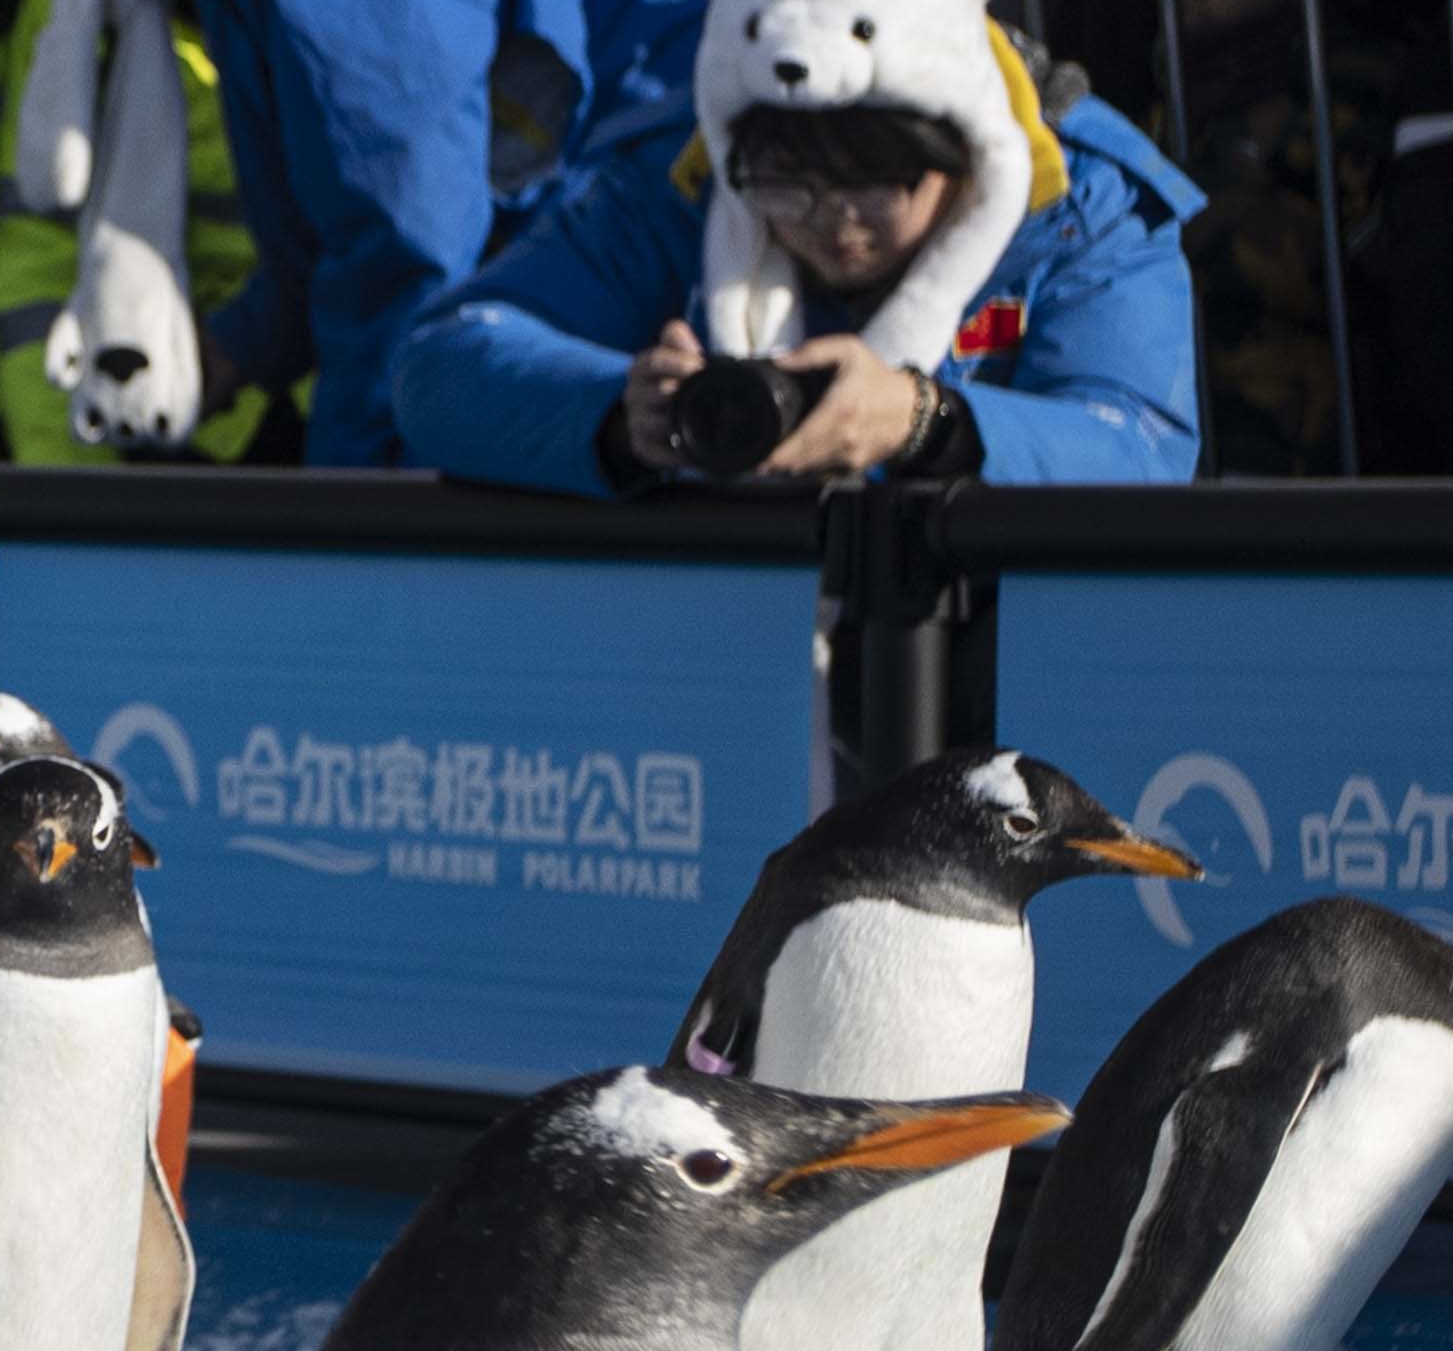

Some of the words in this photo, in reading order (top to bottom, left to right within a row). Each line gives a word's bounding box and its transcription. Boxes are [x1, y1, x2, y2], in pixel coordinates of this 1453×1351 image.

[217, 725, 703, 852] 哈尔滨极地公园
[520, 850, 703, 902] POLARPARK
